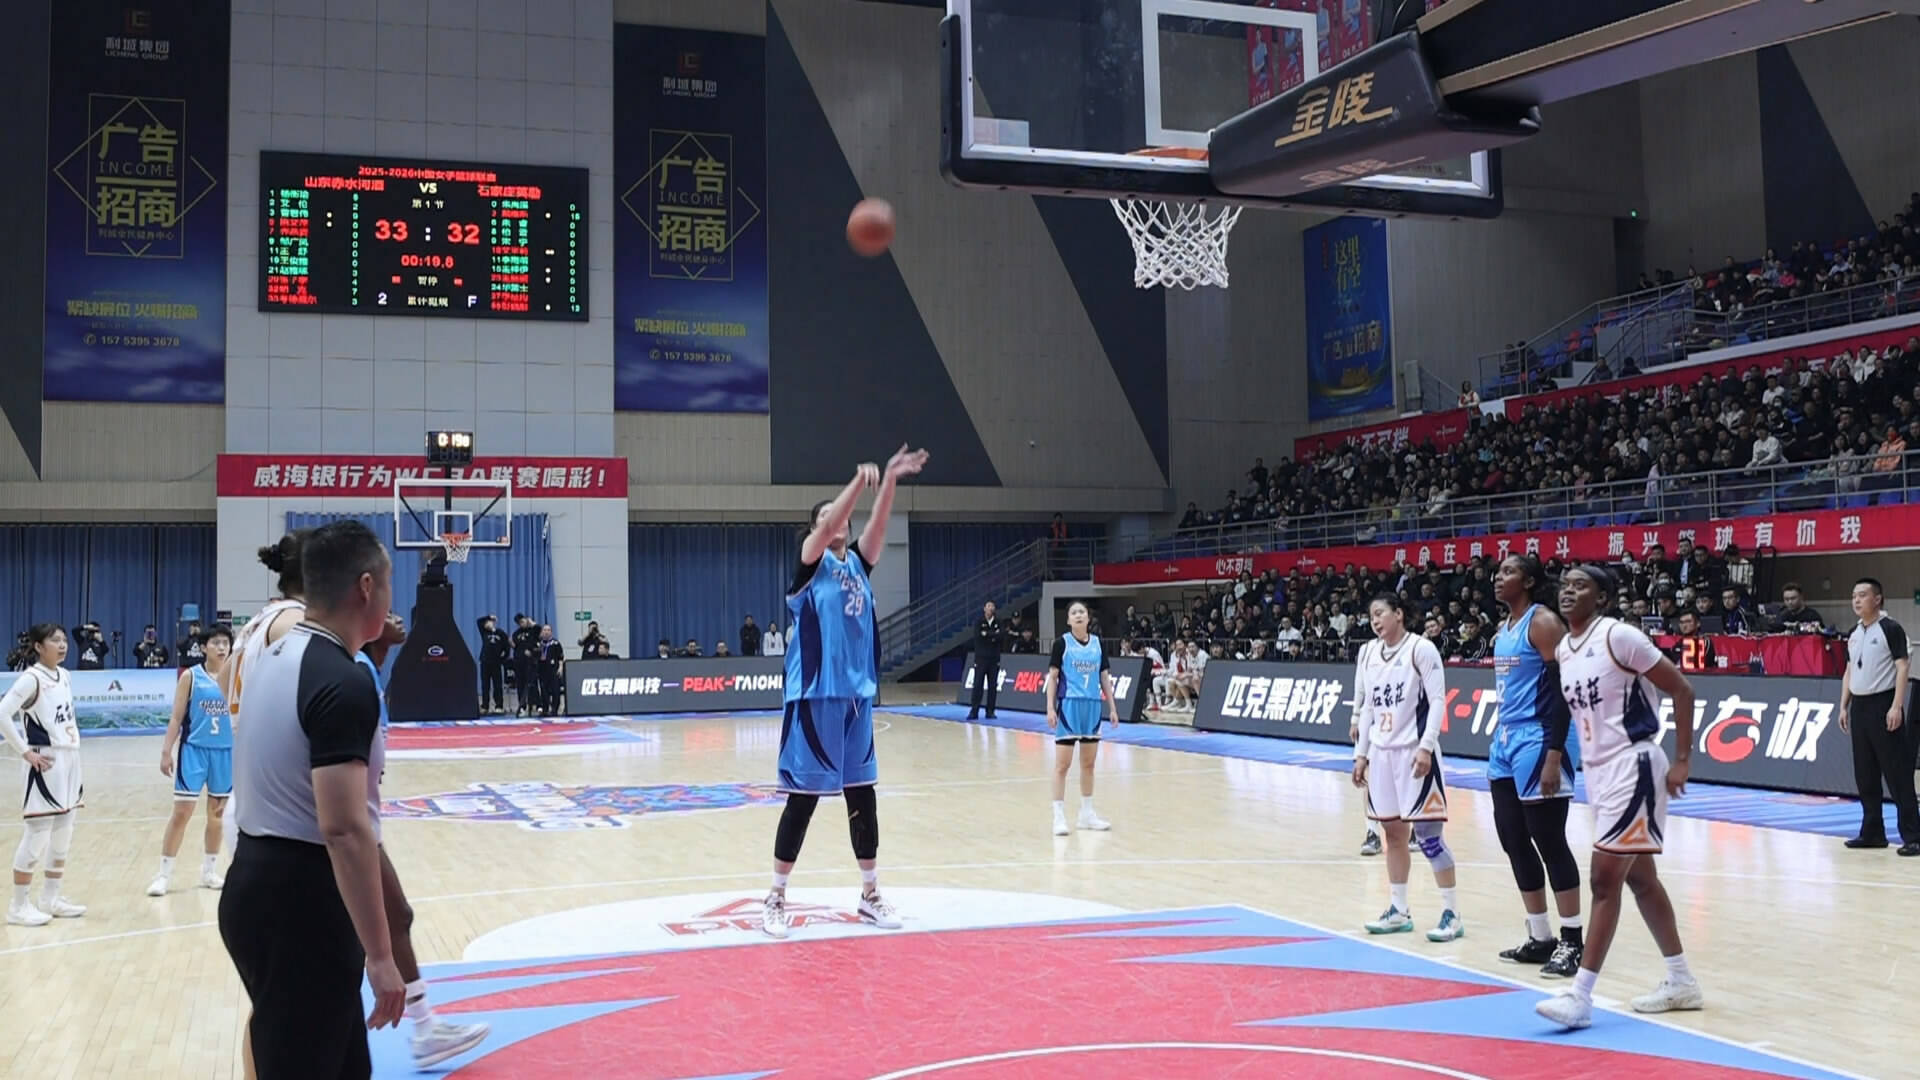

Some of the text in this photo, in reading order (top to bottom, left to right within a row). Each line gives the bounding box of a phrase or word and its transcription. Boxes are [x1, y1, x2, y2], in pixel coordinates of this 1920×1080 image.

[1275, 72, 1393, 147] 金陵
[98, 122, 178, 164] 广告
[99, 161, 175, 177] INCOME
[658, 155, 727, 193] 广告
[419, 182, 438, 194] VS
[97, 186, 177, 229] 招商
[660, 191, 725, 206] INCOME
[376, 219, 409, 240] 33
[447, 222, 480, 245] 32
[658, 213, 727, 254] 招商
[378, 293, 387, 305] 2
[468, 296, 477, 308] F
[101, 335, 120, 345] 157
[664, 351, 681, 361] 157
[844, 593, 865, 617] 29
[580, 678, 662, 697] 匹克黑科技
[1082, 674, 1089, 689] 7
[1221, 675, 1344, 725] 匹克黑科技
[1379, 712, 1393, 733] 23
